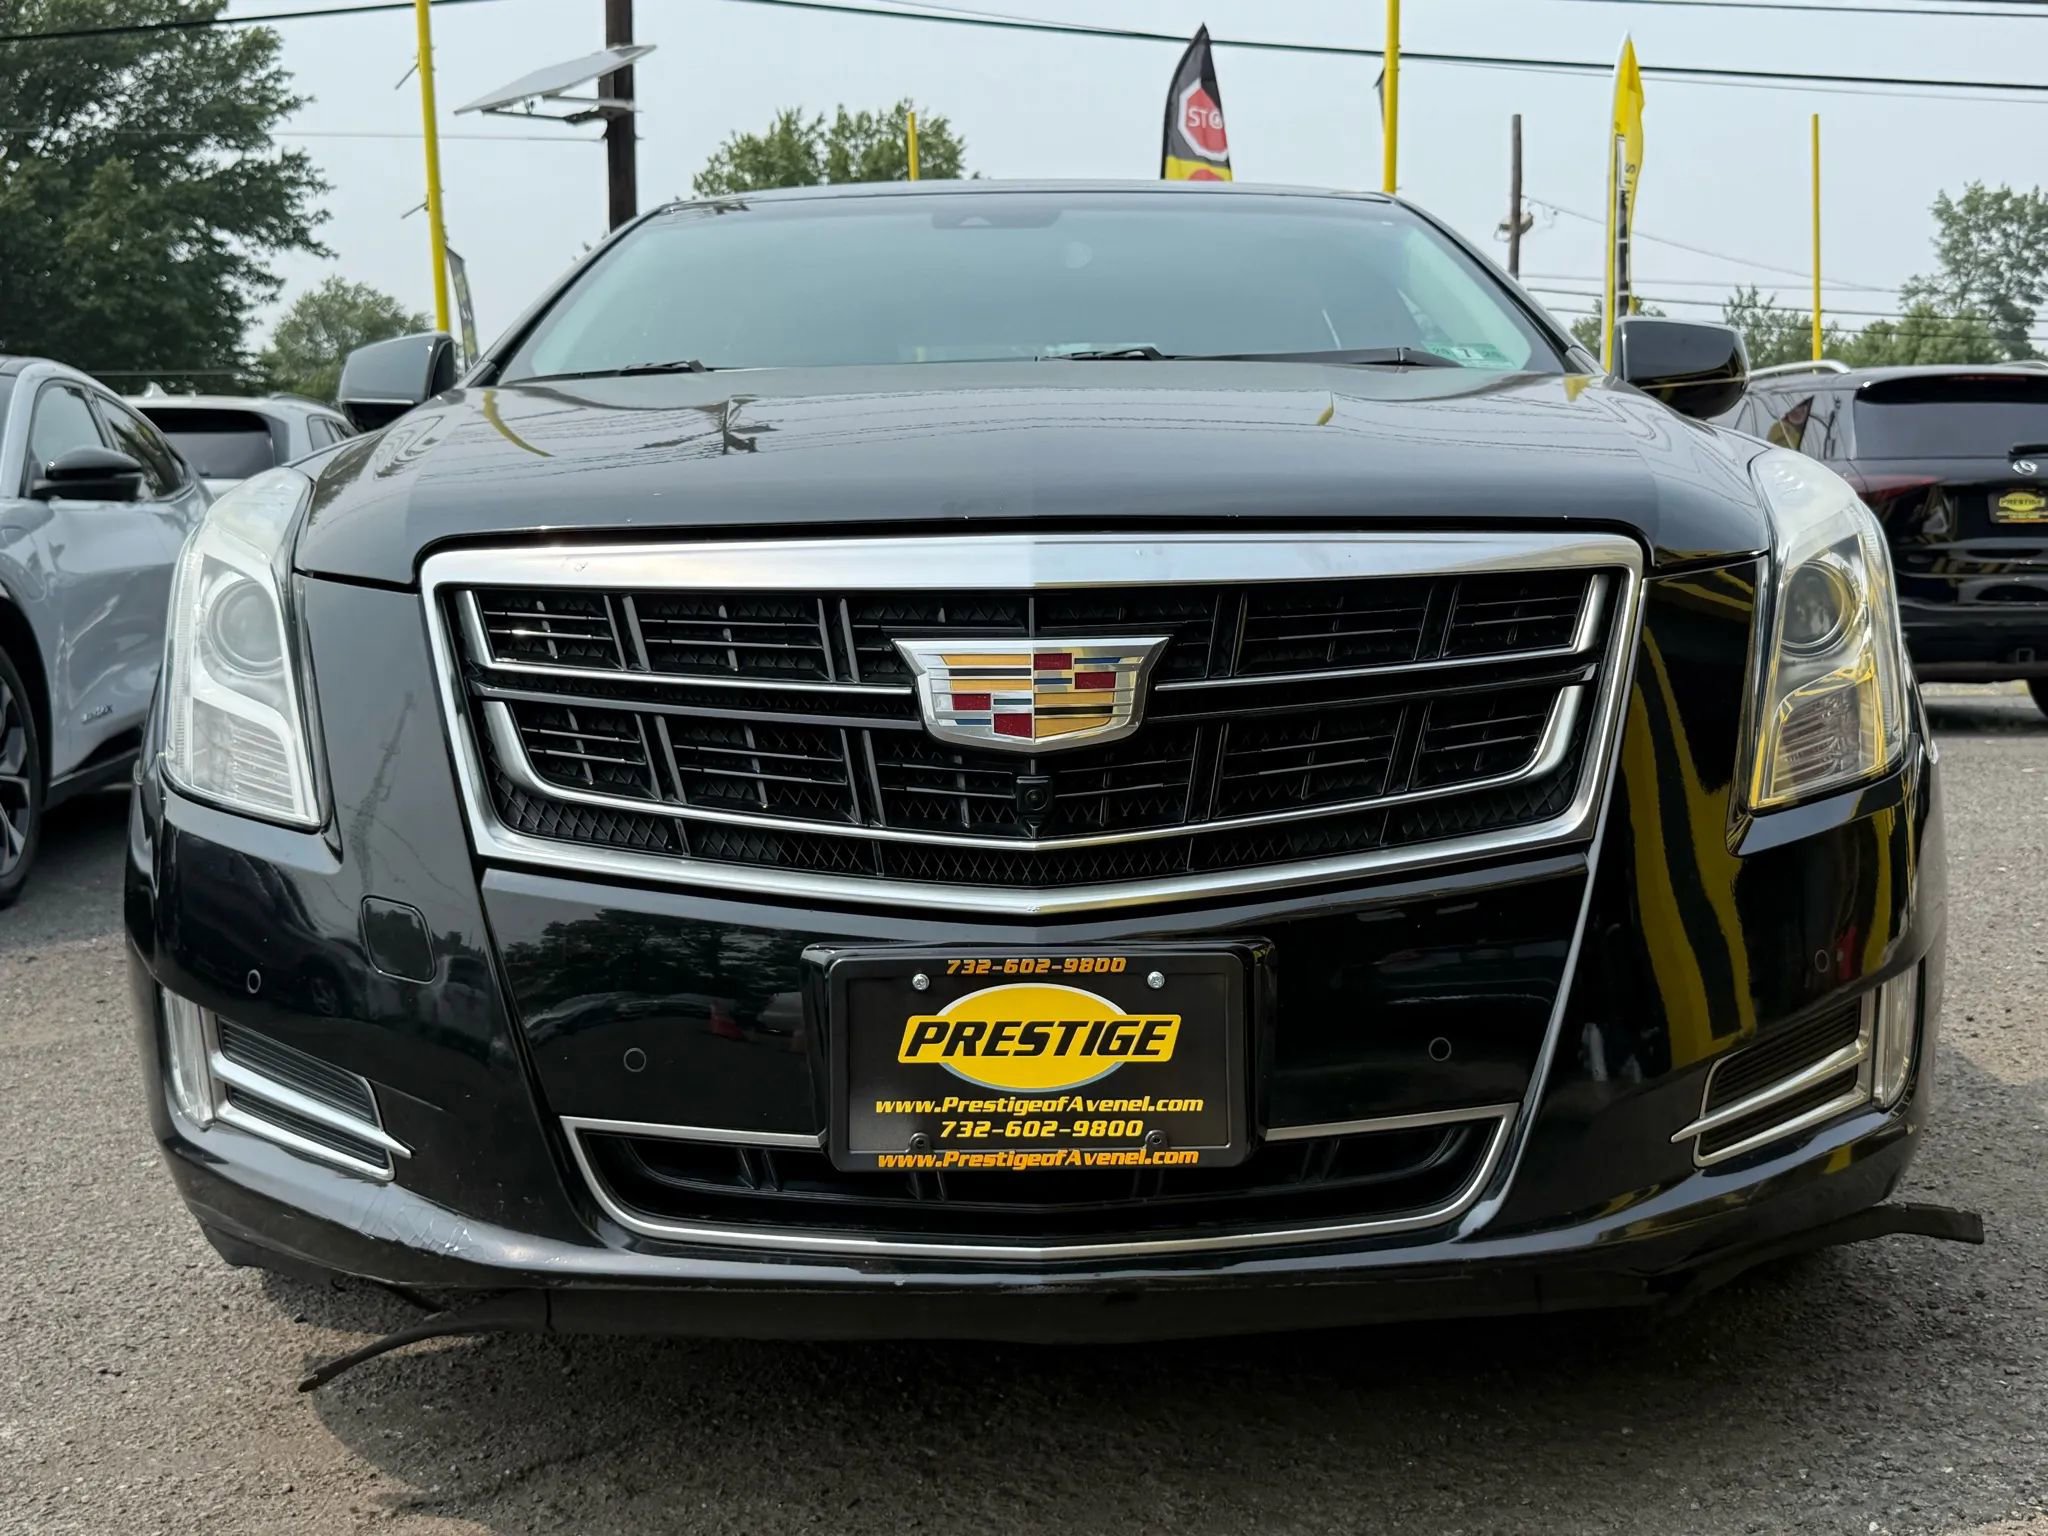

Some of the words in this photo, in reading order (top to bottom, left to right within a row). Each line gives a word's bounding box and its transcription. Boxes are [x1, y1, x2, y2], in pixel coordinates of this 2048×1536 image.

[1187, 107, 1223, 129] STO
[946, 957, 1127, 974] 732-602-9800
[905, 1020, 1174, 1056] PRESTIGE
[876, 1096, 1203, 1117] www.PrestigeofAvenel.com
[939, 1120, 1144, 1138] 732-602-9800
[878, 1149, 1199, 1170] www.PrestigeofAvenel.com
